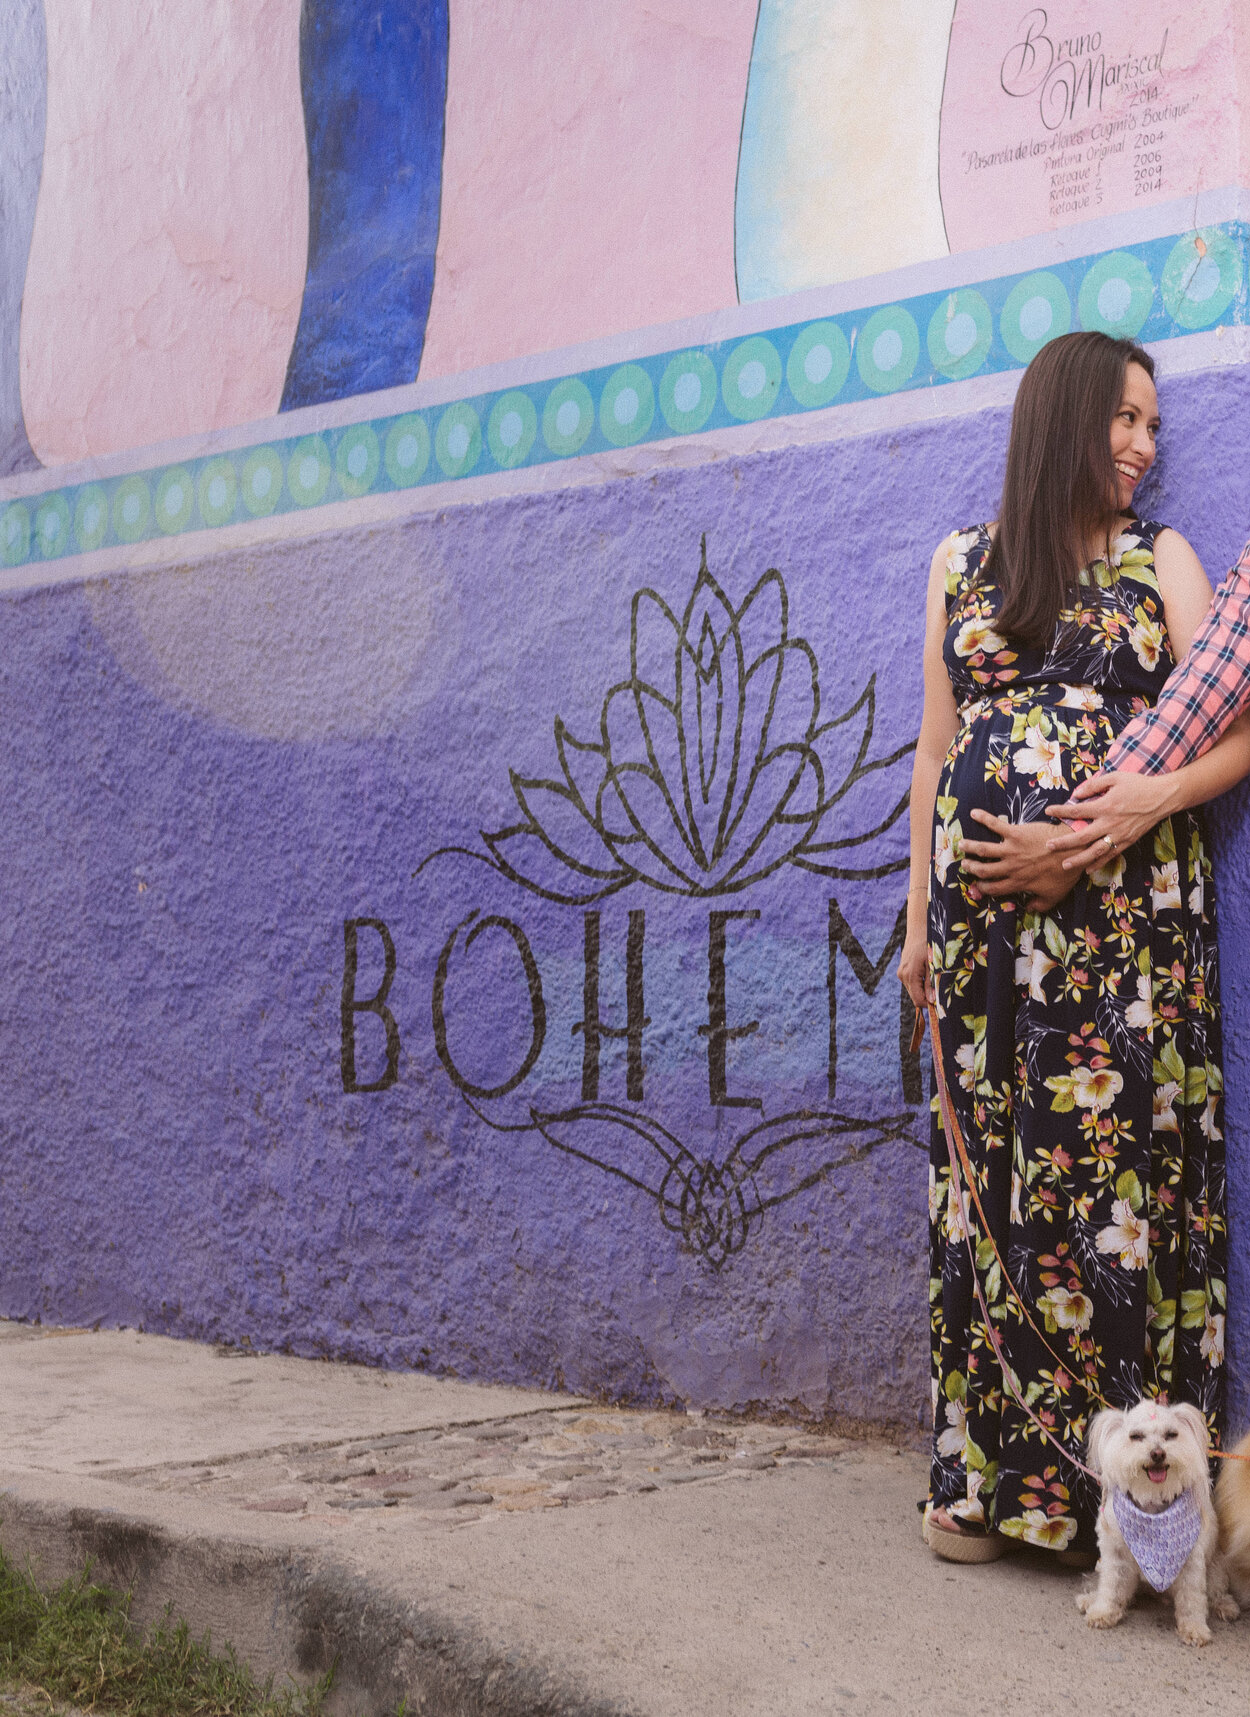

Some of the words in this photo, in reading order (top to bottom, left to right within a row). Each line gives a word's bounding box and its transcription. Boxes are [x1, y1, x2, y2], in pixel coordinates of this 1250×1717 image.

[1000, 8, 1102, 97] Bruno
[1039, 27, 1168, 131] Mariscal
[1129, 85, 1160, 108] 2014
[1086, 133, 1127, 162] Original
[1133, 130, 1164, 149] 2004
[1133, 149, 1162, 168] 2006
[1095, 178, 1103, 191] 2
[1134, 165, 1162, 181] 2009
[1134, 178, 1162, 196] 2014
